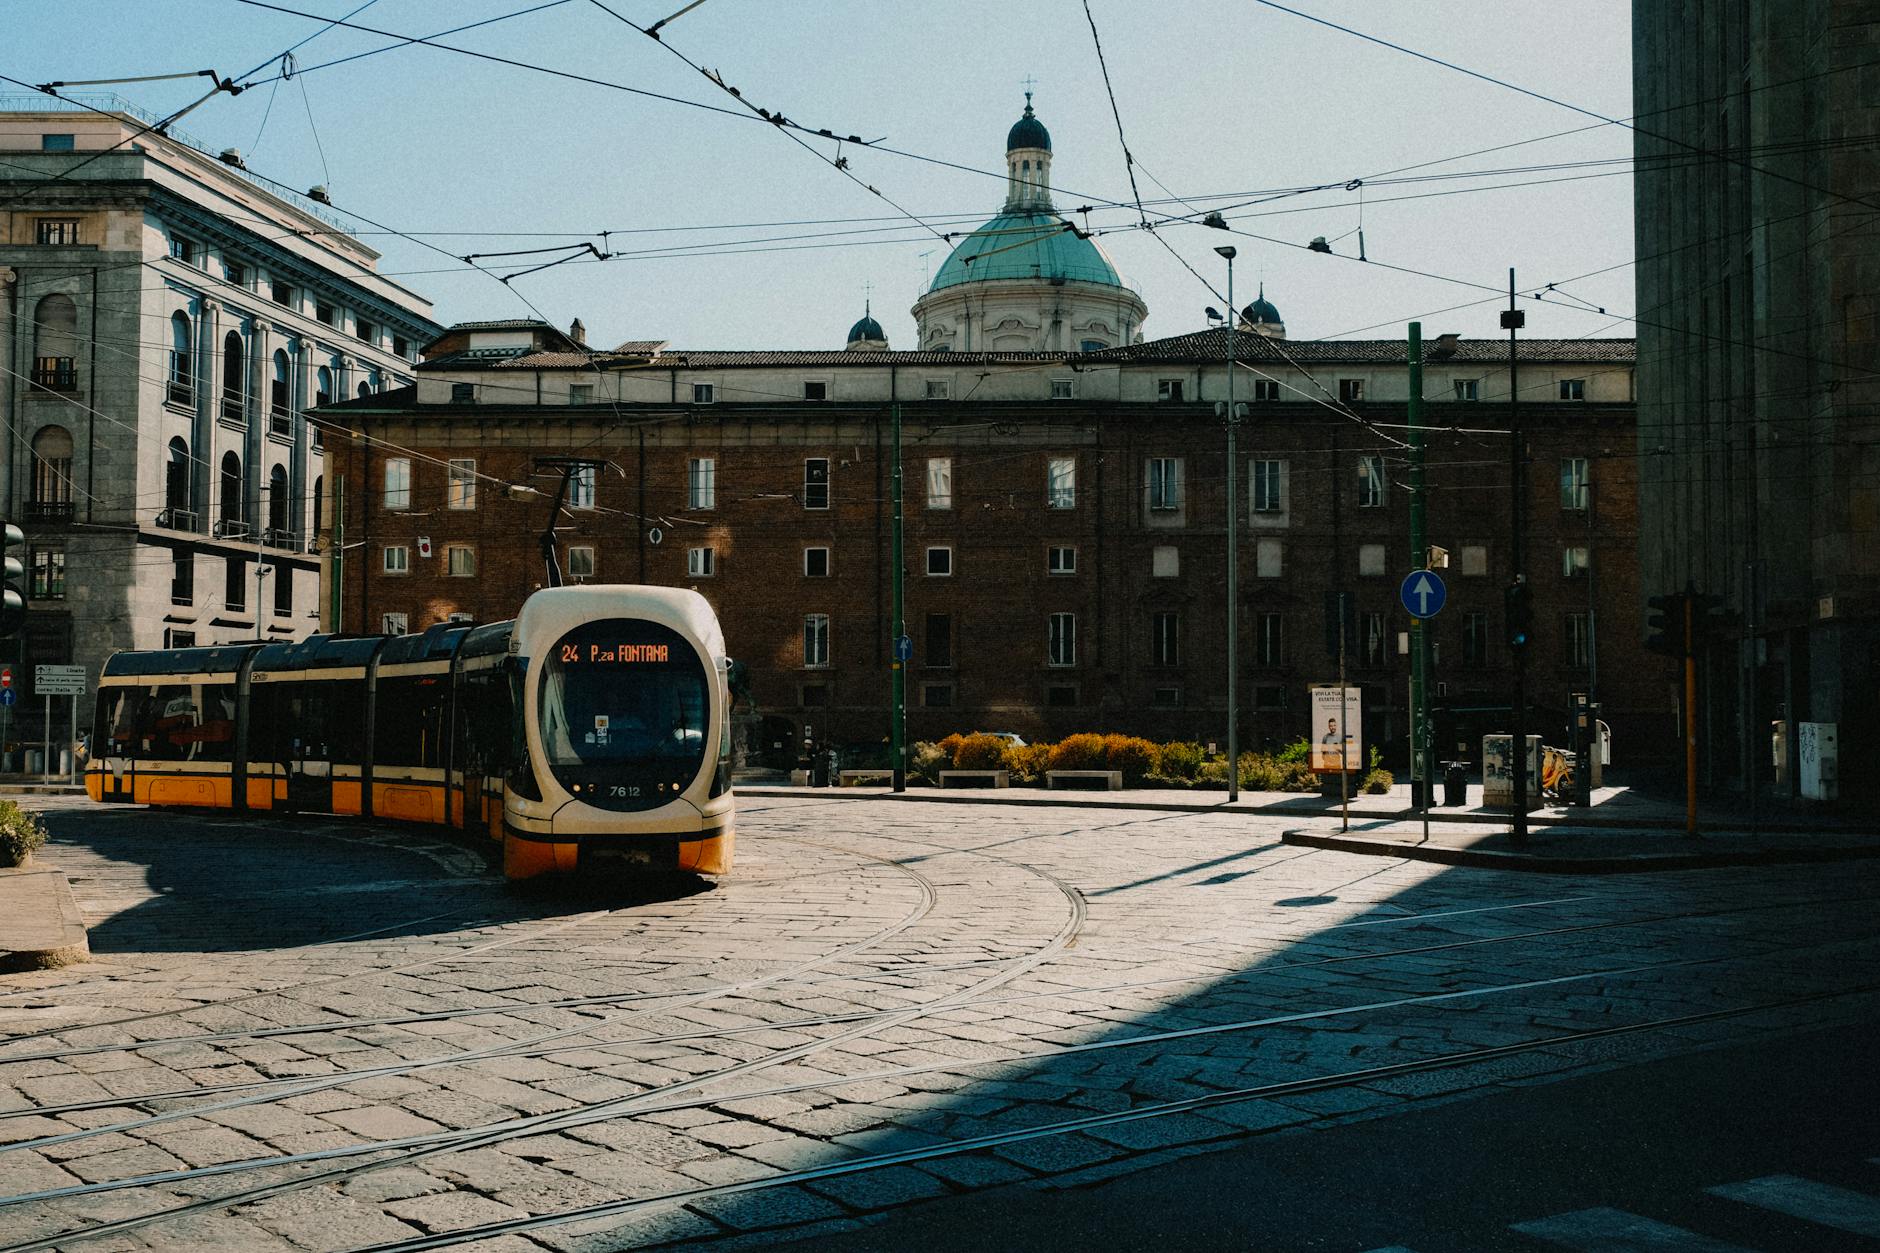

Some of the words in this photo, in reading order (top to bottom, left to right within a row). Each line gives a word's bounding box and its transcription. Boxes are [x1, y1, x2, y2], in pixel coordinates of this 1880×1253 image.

[562, 645, 579, 662] 24
[591, 645, 615, 662] P.za
[618, 645, 668, 662] FONTANA
[609, 786, 640, 797] 7612
